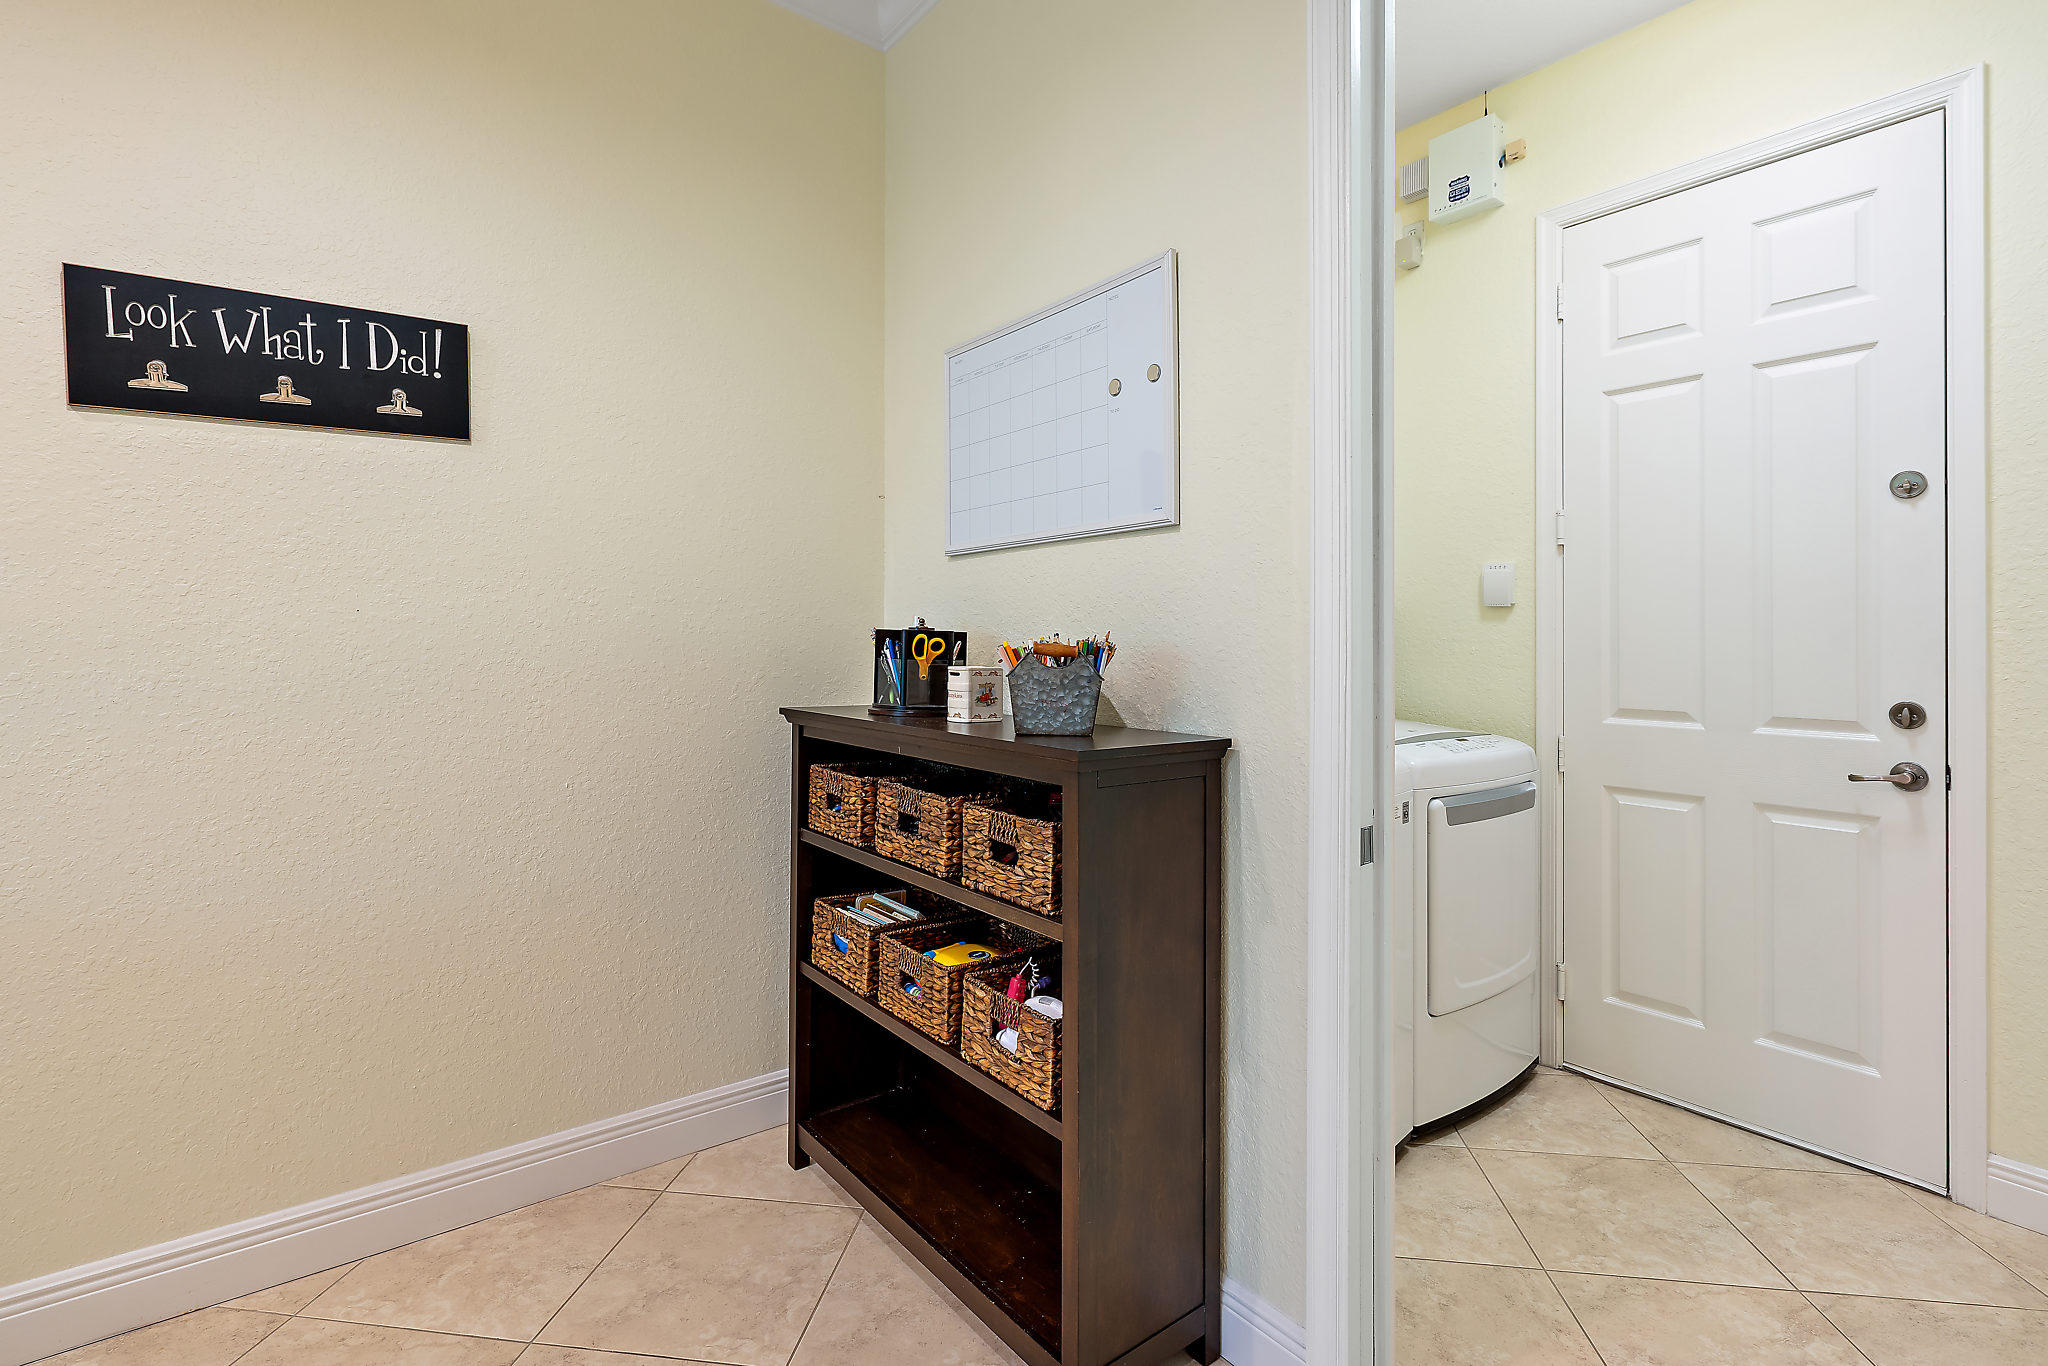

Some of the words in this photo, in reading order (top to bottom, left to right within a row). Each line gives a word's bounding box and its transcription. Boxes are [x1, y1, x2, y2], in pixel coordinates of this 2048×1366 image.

[101, 284, 197, 349] Look
[211, 306, 324, 366] What
[337, 318, 351, 370] I
[365, 321, 442, 379] Did!
